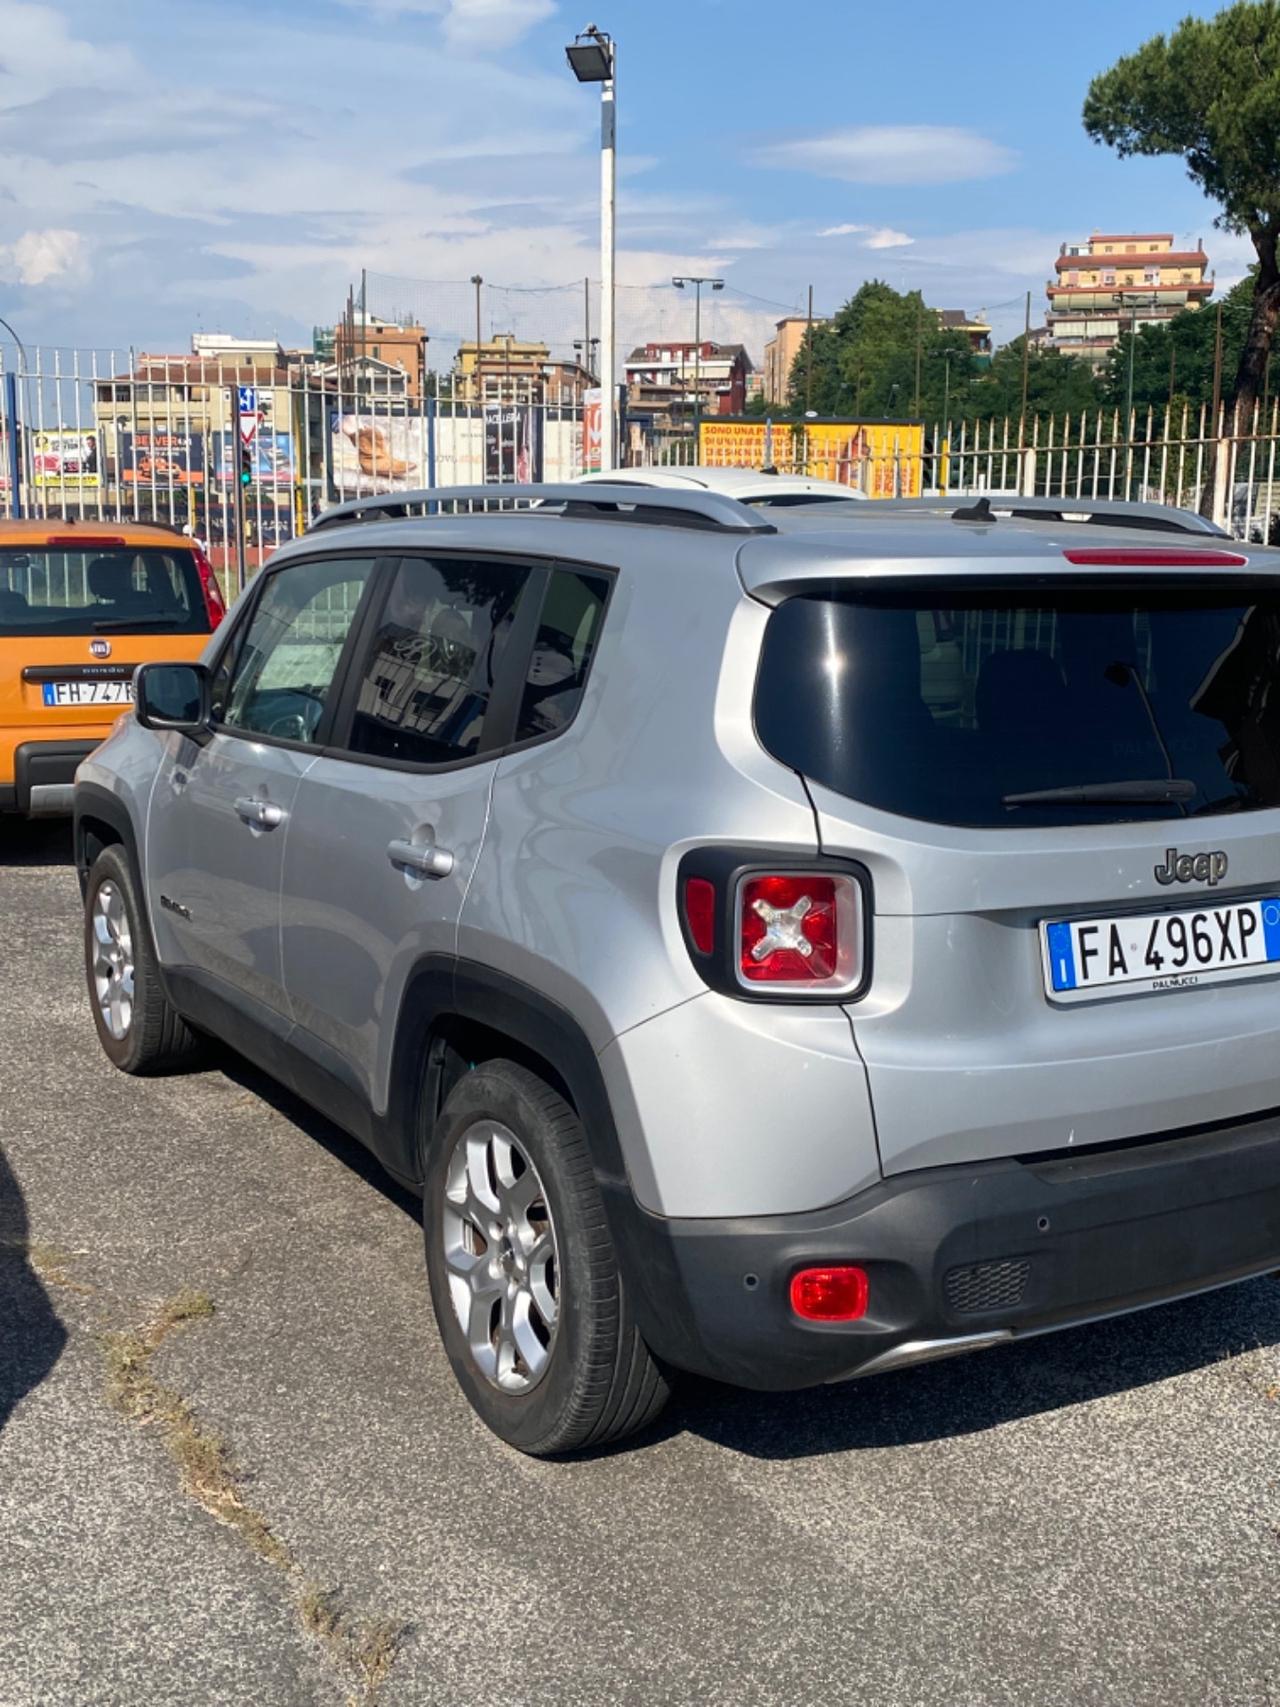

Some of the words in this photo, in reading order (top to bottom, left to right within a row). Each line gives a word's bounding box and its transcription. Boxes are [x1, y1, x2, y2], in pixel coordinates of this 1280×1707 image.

[704, 426, 732, 435] SONO
[734, 426, 755, 435] UNA
[56, 683, 81, 703] FH
[1154, 847, 1229, 886] Jeep
[1078, 923, 1128, 979] FA
[1144, 908, 1257, 971] 496XP
[1152, 975, 1199, 990] PALMUCCI
